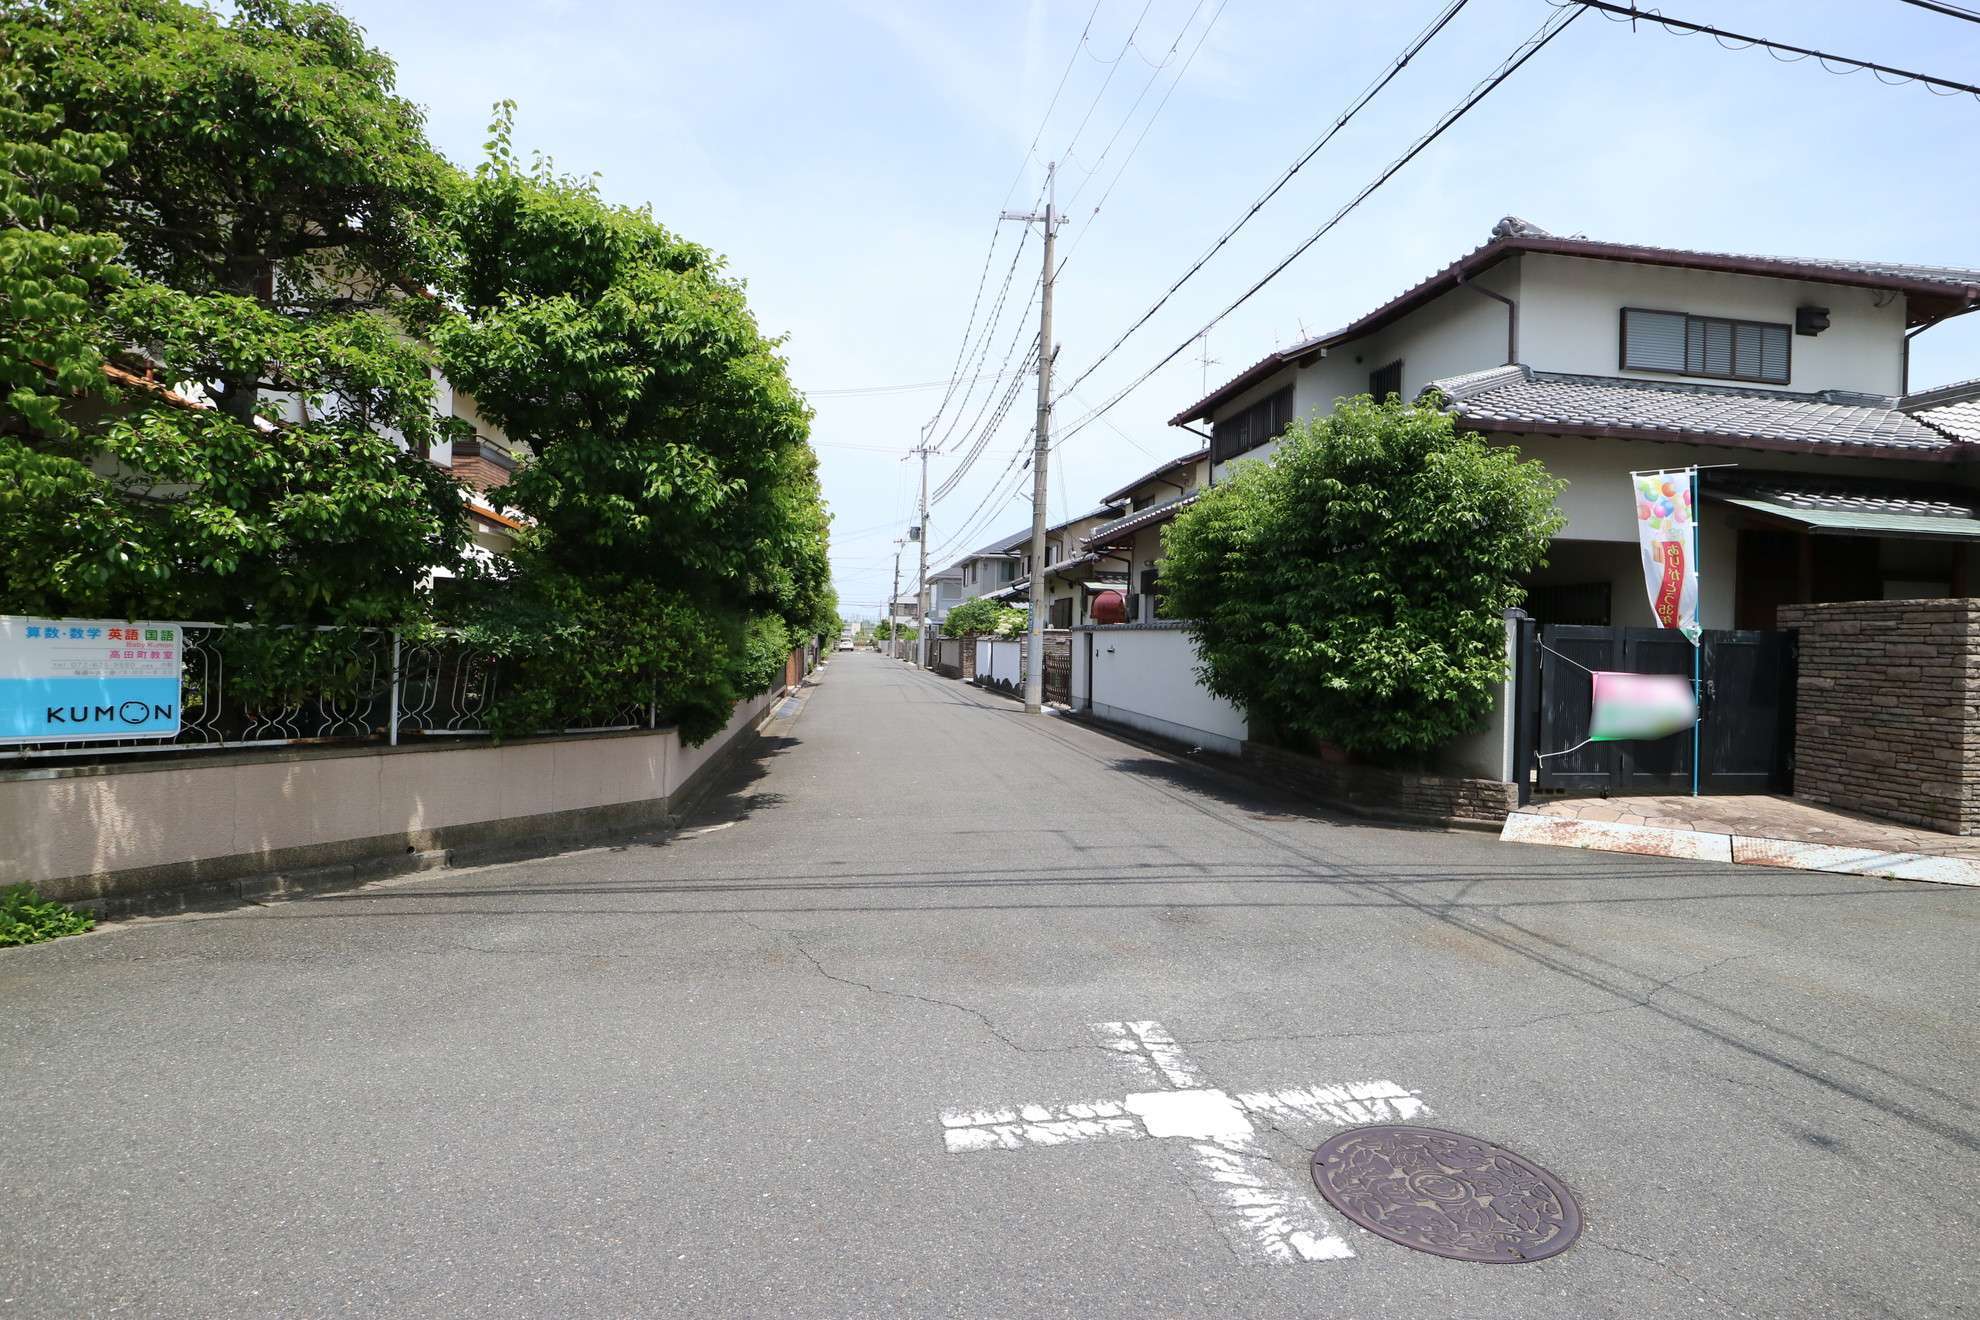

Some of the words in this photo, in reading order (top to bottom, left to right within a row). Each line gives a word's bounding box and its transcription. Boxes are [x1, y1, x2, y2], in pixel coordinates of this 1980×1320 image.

[108, 628, 139, 640] 英語
[145, 629, 174, 641] 国語
[110, 650, 173, 660] 高田町教室
[47, 701, 172, 725] KUMON
